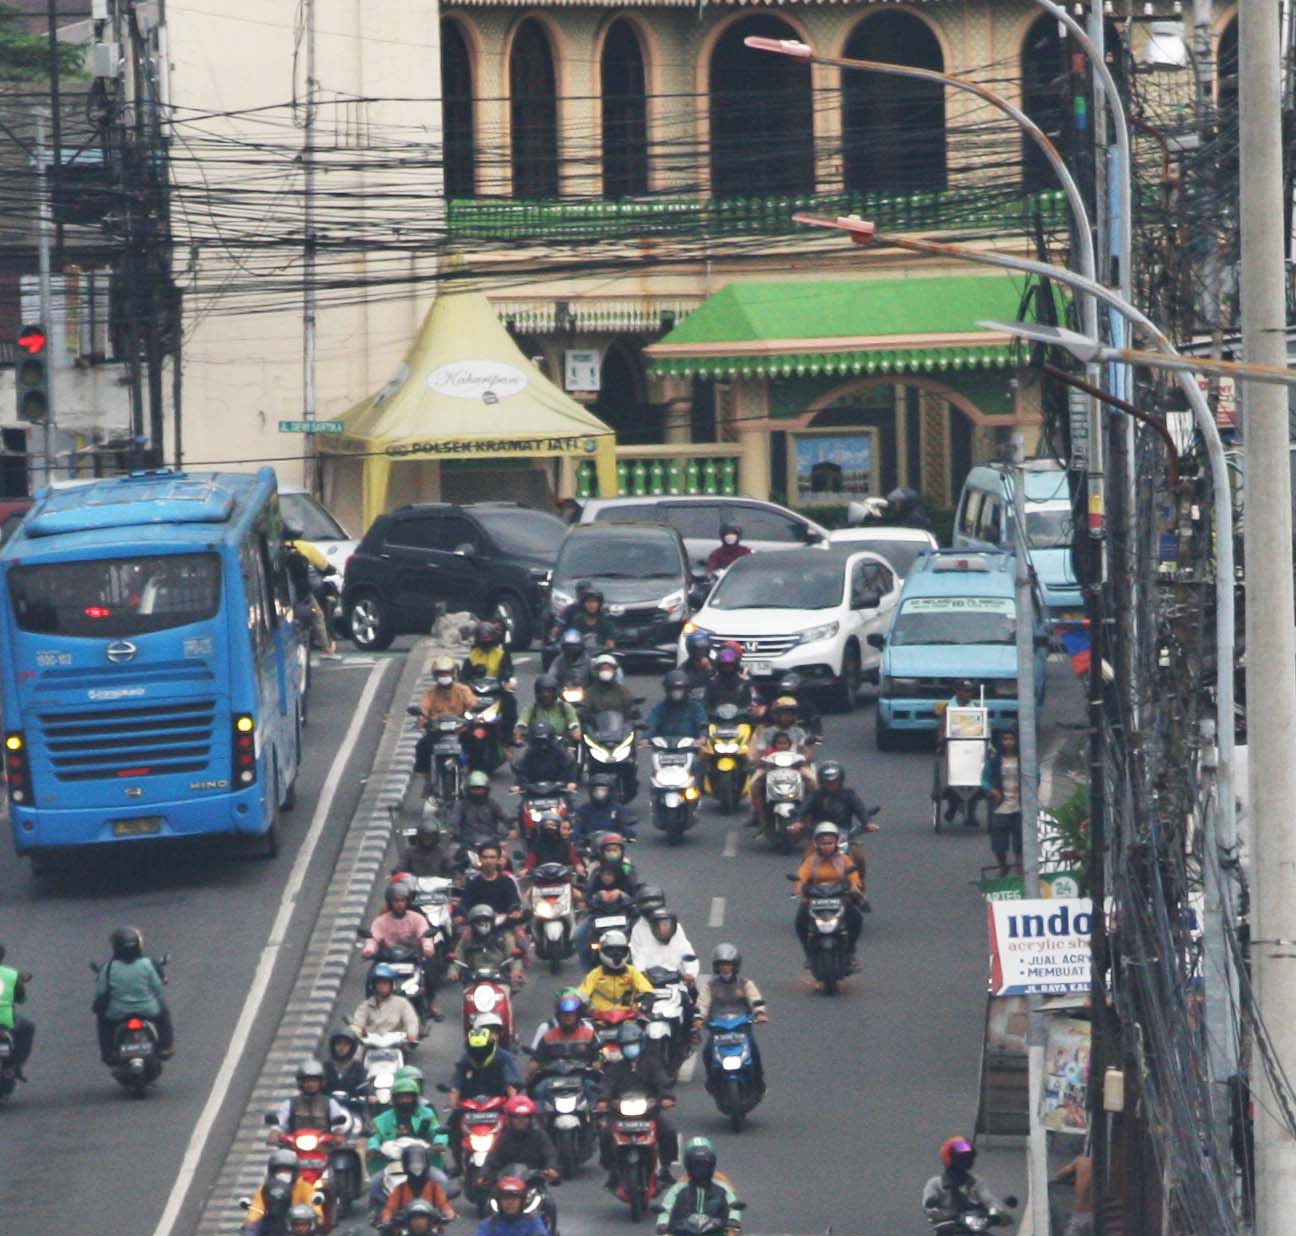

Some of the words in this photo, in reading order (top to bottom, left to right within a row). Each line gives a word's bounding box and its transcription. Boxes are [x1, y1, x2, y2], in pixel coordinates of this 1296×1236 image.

[412, 441, 473, 454] POLSEK
[475, 439, 544, 452] KRAMAT
[547, 438, 578, 450] JATI
[982, 890, 1022, 901] ARTEG
[1008, 938, 1065, 952] acrylic
[1027, 956, 1058, 966] JUAL
[1027, 966, 1085, 977] MEMBUAT
